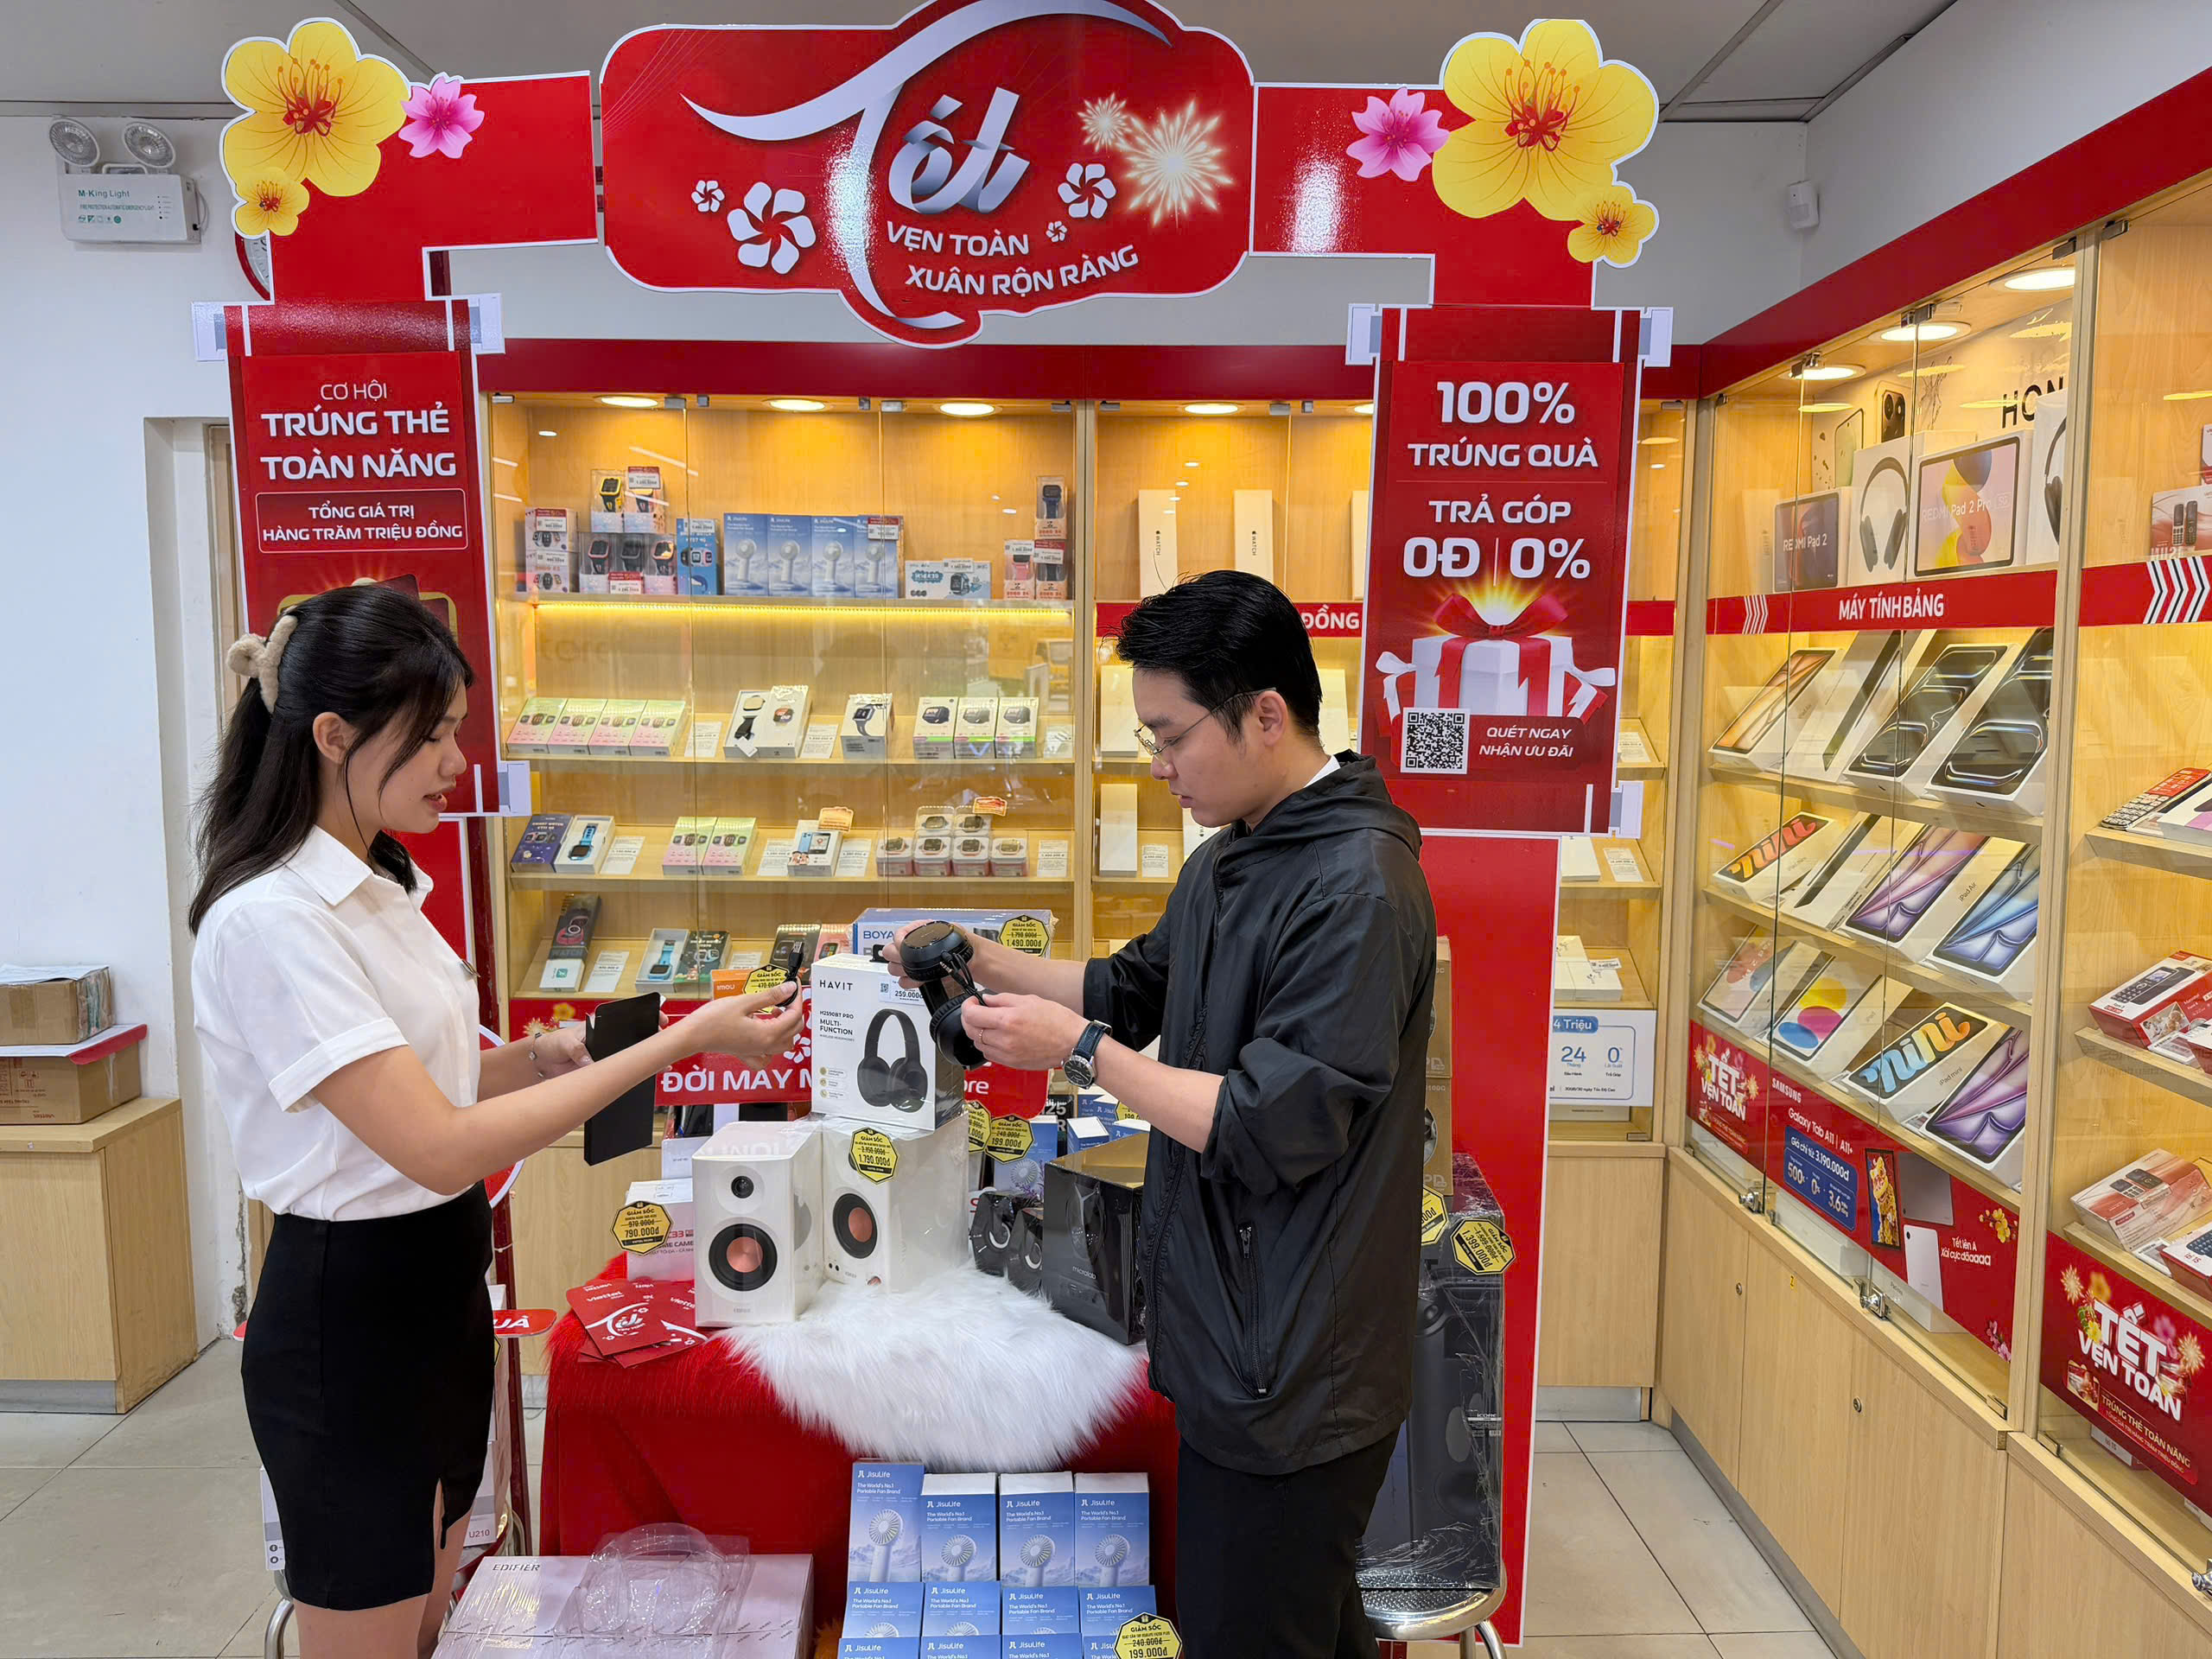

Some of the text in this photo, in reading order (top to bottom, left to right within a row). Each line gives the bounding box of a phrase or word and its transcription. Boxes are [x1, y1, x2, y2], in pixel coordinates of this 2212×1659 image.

[886, 220, 1029, 256] VẸN TOÀN
[906, 245, 1139, 299] XUÂN RỘN RÀNG
[321, 379, 387, 401] CƠ HỘI
[1436, 381, 1575, 424] 100%
[261, 401, 449, 436] TRÚNG THẺ
[1408, 436, 1599, 468] TRÚNG QUÀ
[260, 448, 457, 480] TOÀN NĂNG
[308, 500, 416, 519] TỔNG GIÁ TRỊ
[1429, 493, 1571, 524] TRẢ GÓP
[1951, 500, 1966, 516] Pad
[1969, 500, 1974, 513] 2
[1977, 499, 1991, 512] Pro
[263, 519, 462, 542] HÀNG TRĂM TRIỆU ĐỒNG
[1808, 533, 1827, 548] Pad 2
[1403, 537, 1591, 579] 0Đ 0%
[1839, 588, 1944, 620] MÁY TÍNH BẢNG
[1300, 604, 1360, 630] ĐỒNG
[1486, 722, 1572, 740] QUÉT NGAY
[1478, 741, 1573, 759] NHẬN ƯU ĐÃI
[1958, 888, 1970, 901] iPad
[863, 930, 894, 940] BOYA
[819, 980, 854, 991] HAVIT
[820, 1026, 853, 1035] FUNCTION
[1563, 1019, 1592, 1030] Triệu
[1561, 1046, 1586, 1062] 24
[661, 1064, 715, 1093] ĐỜI
[723, 1069, 793, 1090] MAY
[1708, 1047, 1740, 1096] TẾT
[1939, 1066, 1962, 1086] iPad mini
[1701, 1077, 1719, 1103] VẸN
[1772, 1077, 1802, 1103] SAMSUNG
[1789, 1108, 1811, 1133] Galaxy
[1812, 1121, 1824, 1138] Tab
[1825, 1130, 1834, 1145] A11
[992, 1138, 1021, 1147] 199.000đ
[859, 1154, 890, 1166] 1.790.000đ
[1790, 1137, 1800, 1148] Giá
[1815, 1150, 1849, 1181] 3.190.000đ
[1828, 1190, 1840, 1212] 3.6
[625, 1227, 659, 1237] 790.000đ
[1462, 1230, 1493, 1268] 1.399.000đ
[1941, 1247, 1961, 1262] Xài cực
[1952, 1236, 1977, 1251] Tết lên A
[1072, 1266, 1096, 1280] microlab
[2094, 1299, 2166, 1379] TẾT
[2078, 1329, 2118, 1376] VẸN
[2101, 1395, 2126, 1420] TRÚNG
[2127, 1414, 2143, 1433] THẺ
[2144, 1426, 2166, 1450] TOÀN
[2166, 1444, 2190, 1468] NĂNG
[469, 1529, 490, 1538] U210
[1129, 1647, 1167, 1658] 199.000đ
